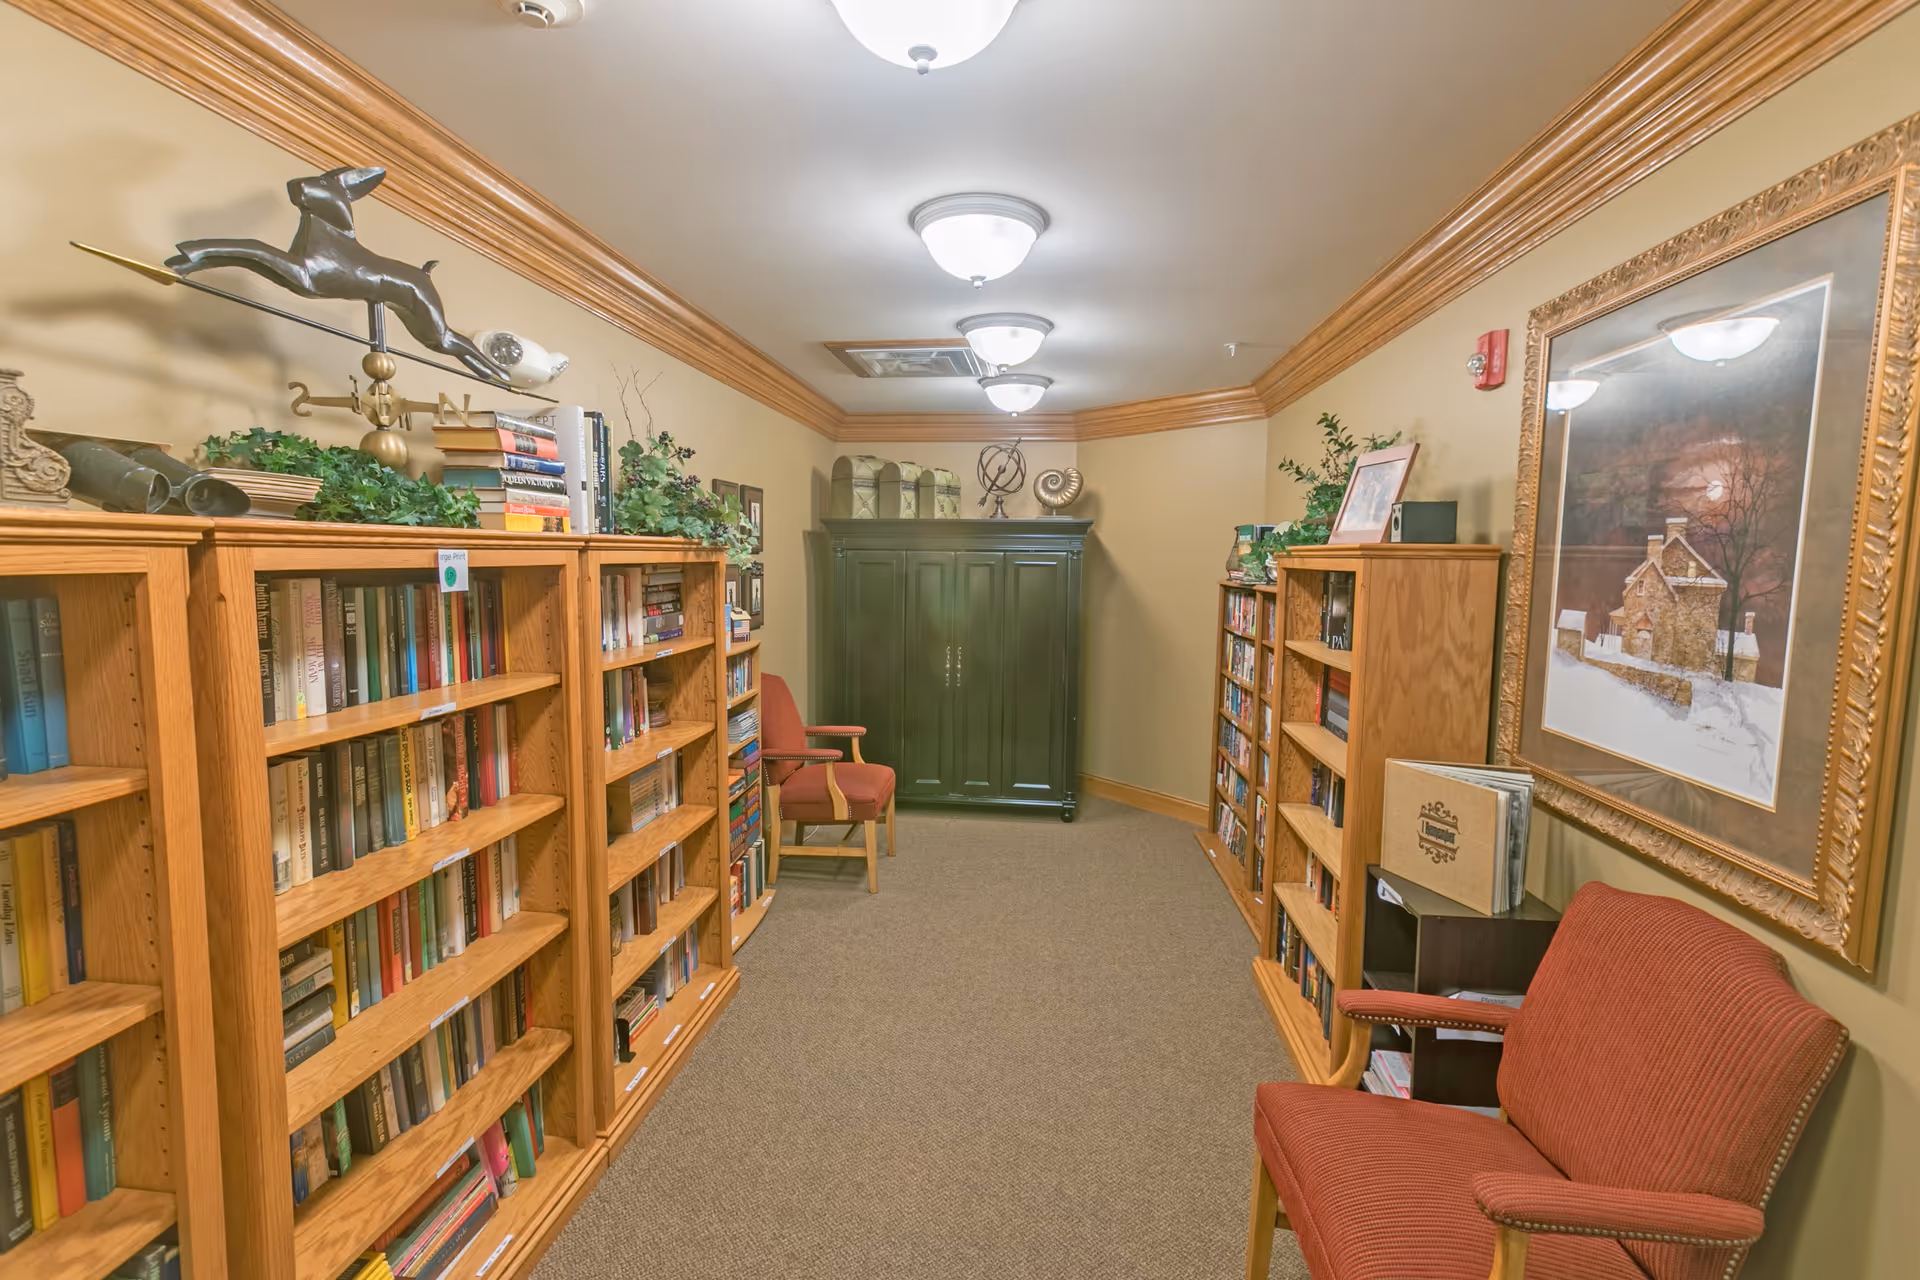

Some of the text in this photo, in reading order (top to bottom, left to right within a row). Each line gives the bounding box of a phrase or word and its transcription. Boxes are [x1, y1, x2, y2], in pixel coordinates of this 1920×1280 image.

[505, 475, 527, 486] QUEEN
[527, 477, 554, 489] VICTORIA
[440, 553, 451, 563] arge
[255, 582, 270, 640] Judith Krantz
[259, 649, 272, 676] Lovers
[308, 660, 318, 683] AGAIN
[16, 650, 41, 718] Shad Run
[297, 805, 306, 842] TELEGRAPH
[1, 883, 16, 920] Dorothy
[393, 909, 401, 953] PARRISH
[281, 953, 295, 968] OUR
[98, 1101, 111, 1141] Tyrants
